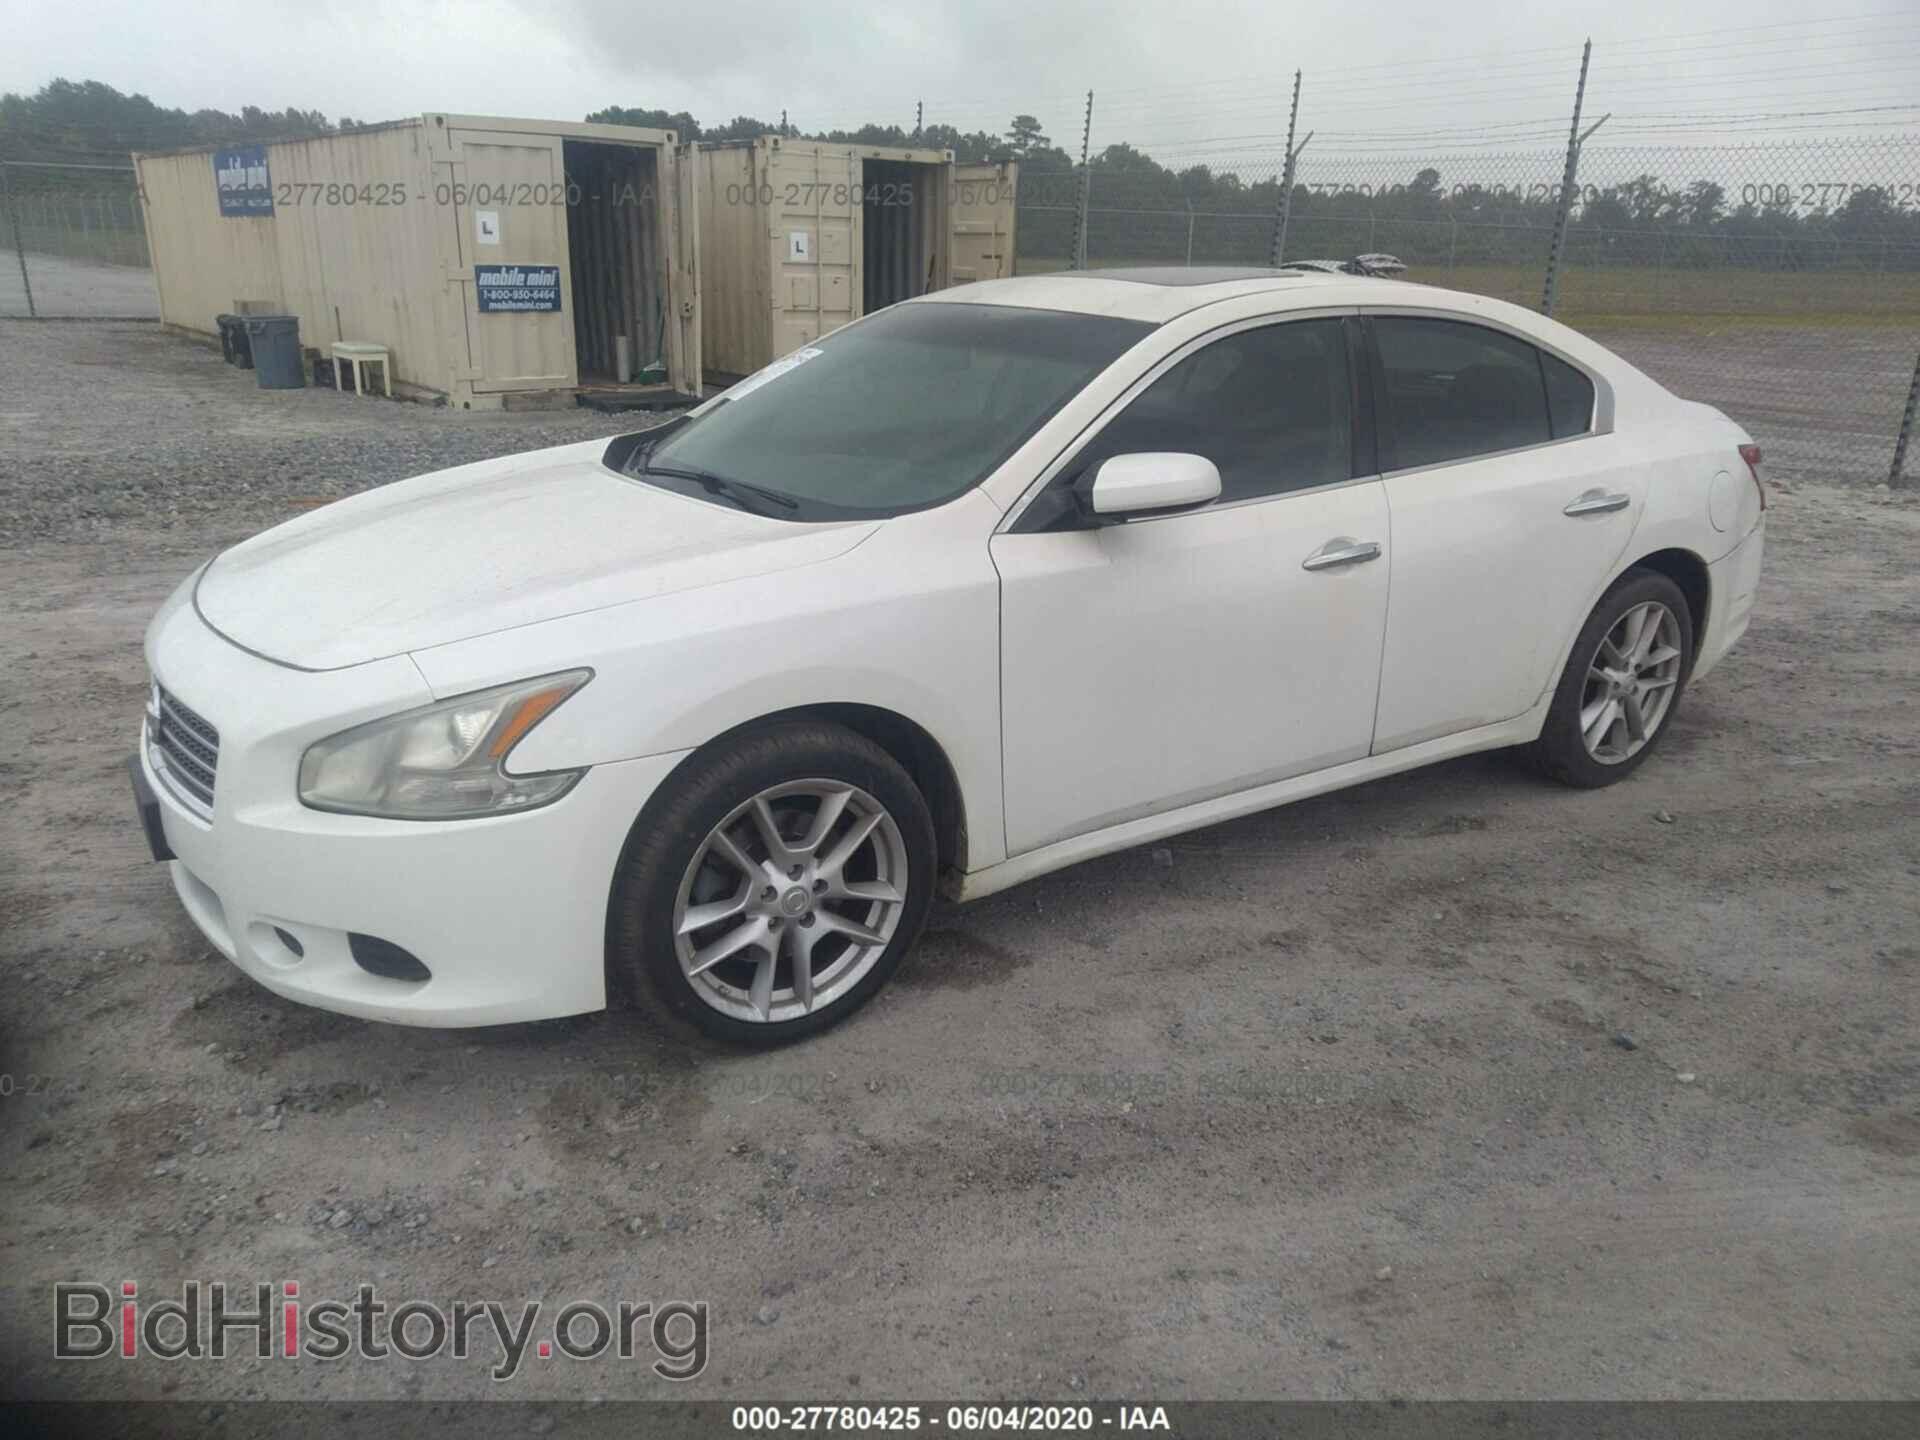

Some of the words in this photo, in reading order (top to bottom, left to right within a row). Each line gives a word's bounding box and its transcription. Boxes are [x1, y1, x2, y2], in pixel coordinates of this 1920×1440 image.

[482, 221, 493, 234] L
[479, 267, 525, 285] mobile
[526, 269, 557, 285] mini
